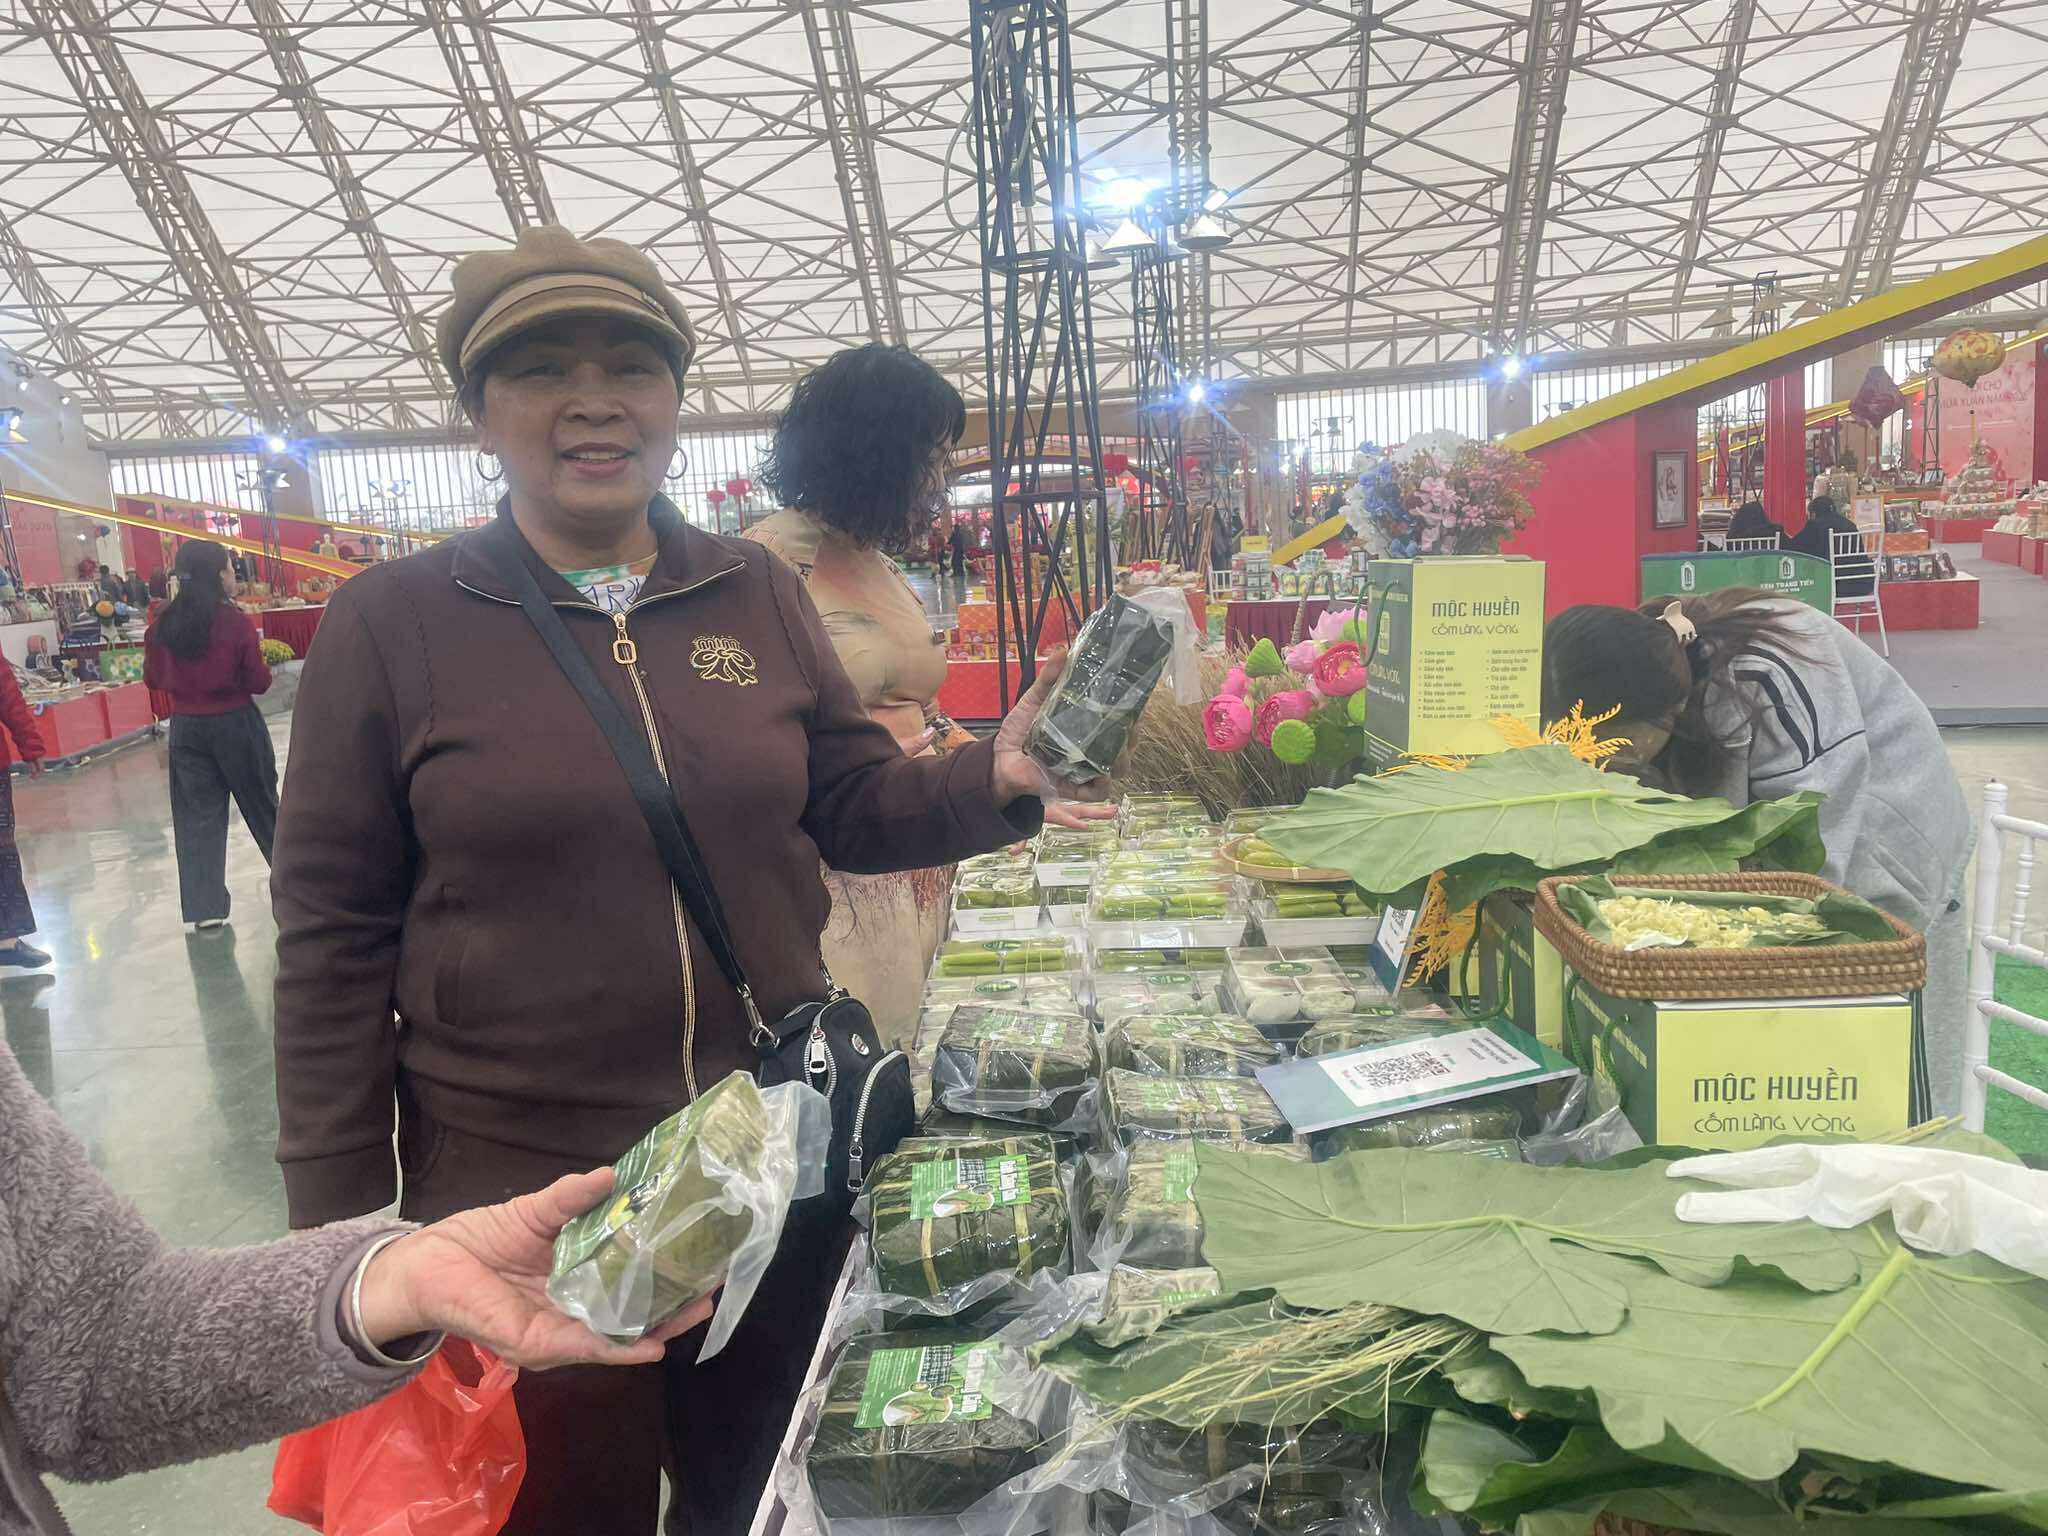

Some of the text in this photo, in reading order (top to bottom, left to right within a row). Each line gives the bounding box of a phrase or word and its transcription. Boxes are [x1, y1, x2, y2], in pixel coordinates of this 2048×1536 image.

[1432, 595, 1520, 618] MỘC HUYỀN
[1432, 622, 1458, 635] CỐM
[1486, 622, 1519, 635] VÒNG
[1694, 1067, 1858, 1104] MỘC HUYỀN
[1694, 1112, 1856, 1134] CỐM LÀNG VÒNG
